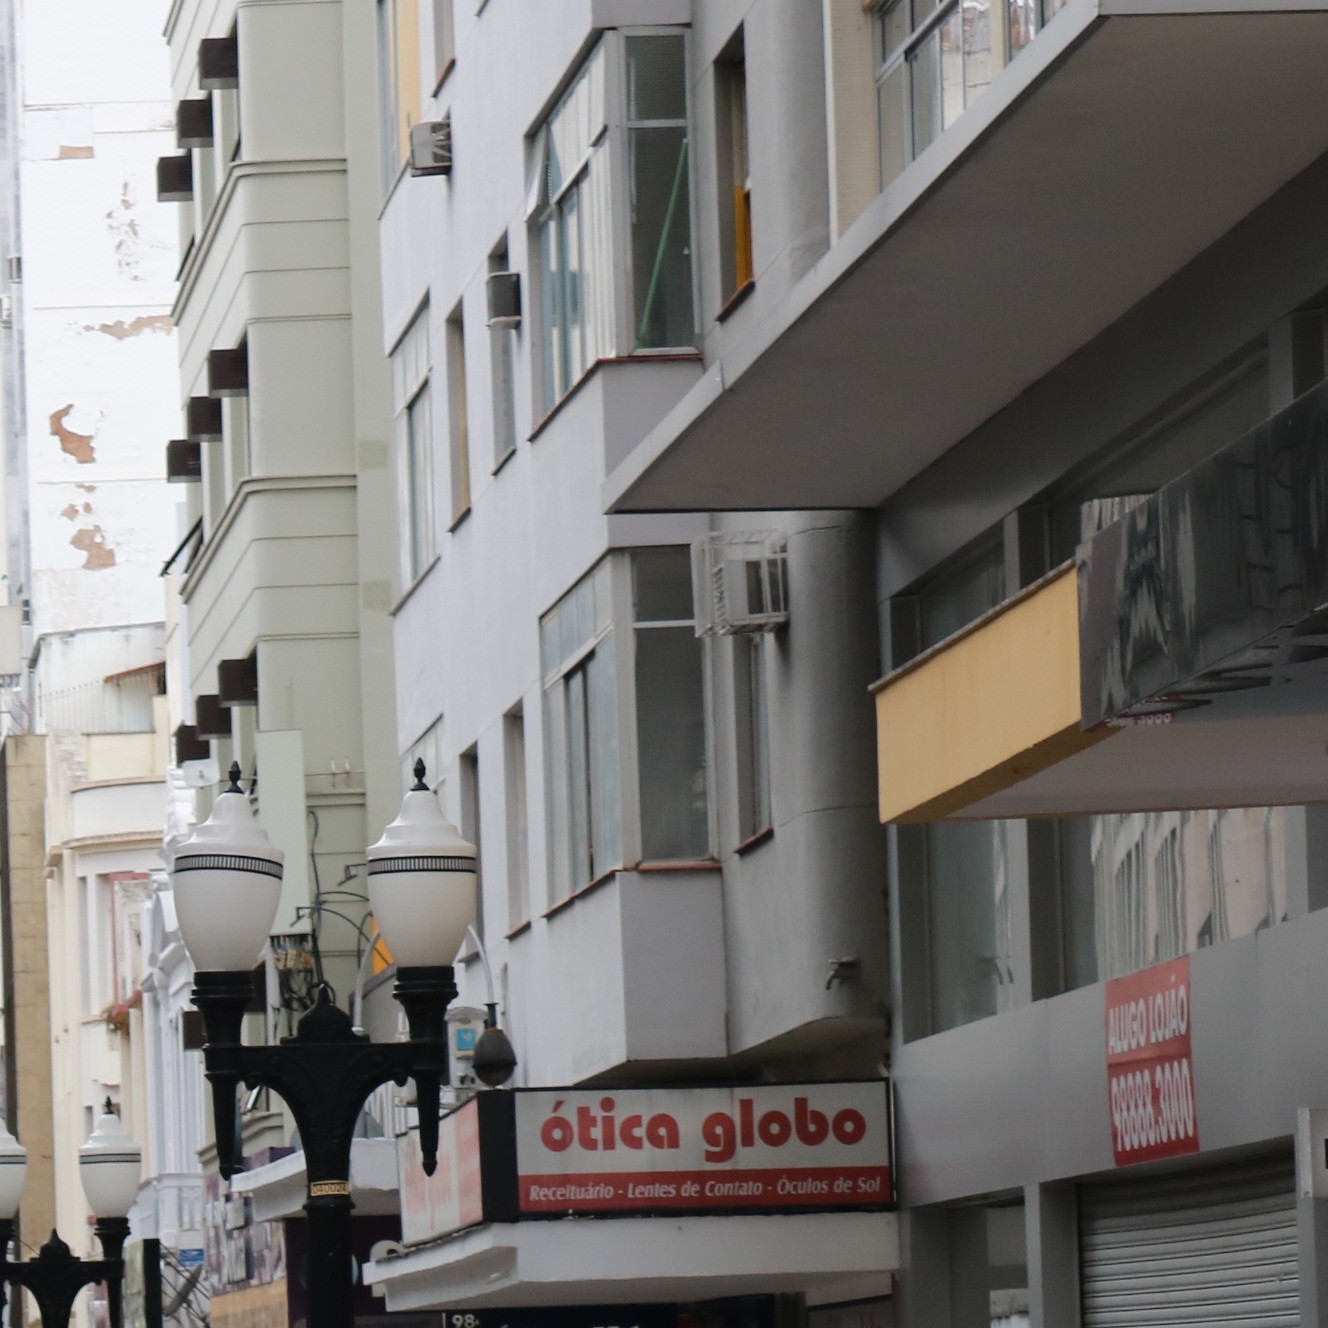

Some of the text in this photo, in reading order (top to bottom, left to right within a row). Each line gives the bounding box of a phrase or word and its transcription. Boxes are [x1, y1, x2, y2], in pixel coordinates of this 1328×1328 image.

[1109, 975, 1188, 1055] ALUGO LOJÃO
[540, 1097, 866, 1163] ótica globo
[1111, 1058, 1194, 1152] 98888.3000
[529, 1175, 880, 1201] Receituário Lentes de Contato Óculos de Sol
